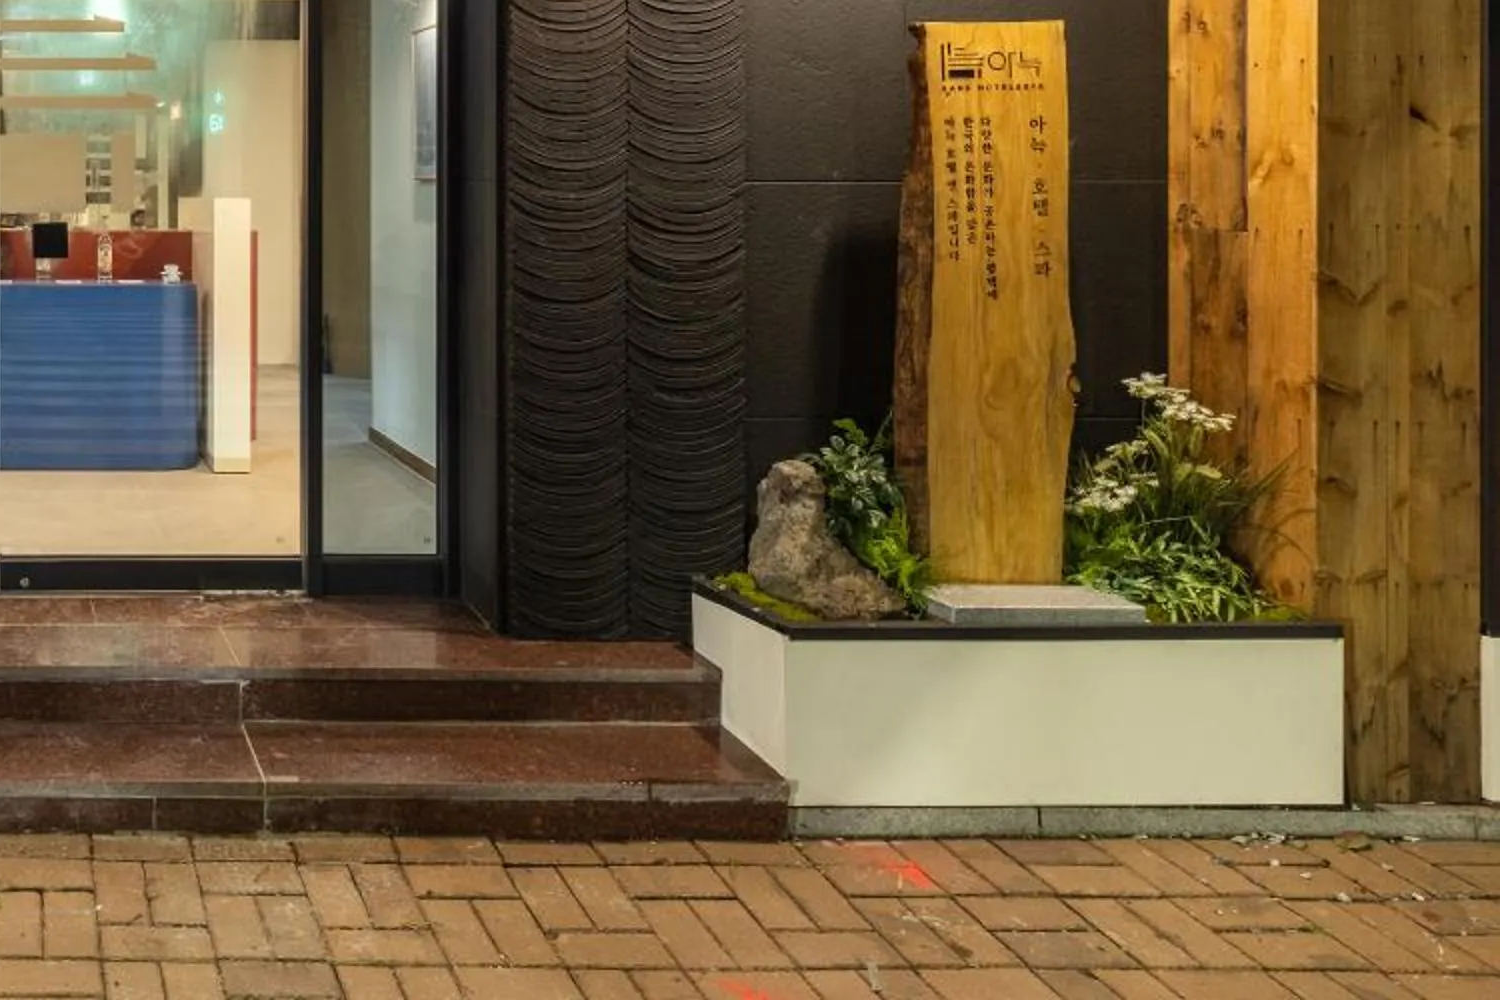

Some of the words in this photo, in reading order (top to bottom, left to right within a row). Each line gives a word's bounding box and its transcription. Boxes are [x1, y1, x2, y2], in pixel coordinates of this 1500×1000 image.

[1029, 115, 1047, 153] 아늑
[1032, 178, 1049, 217] 호텔
[1035, 242, 1052, 277] 스파
